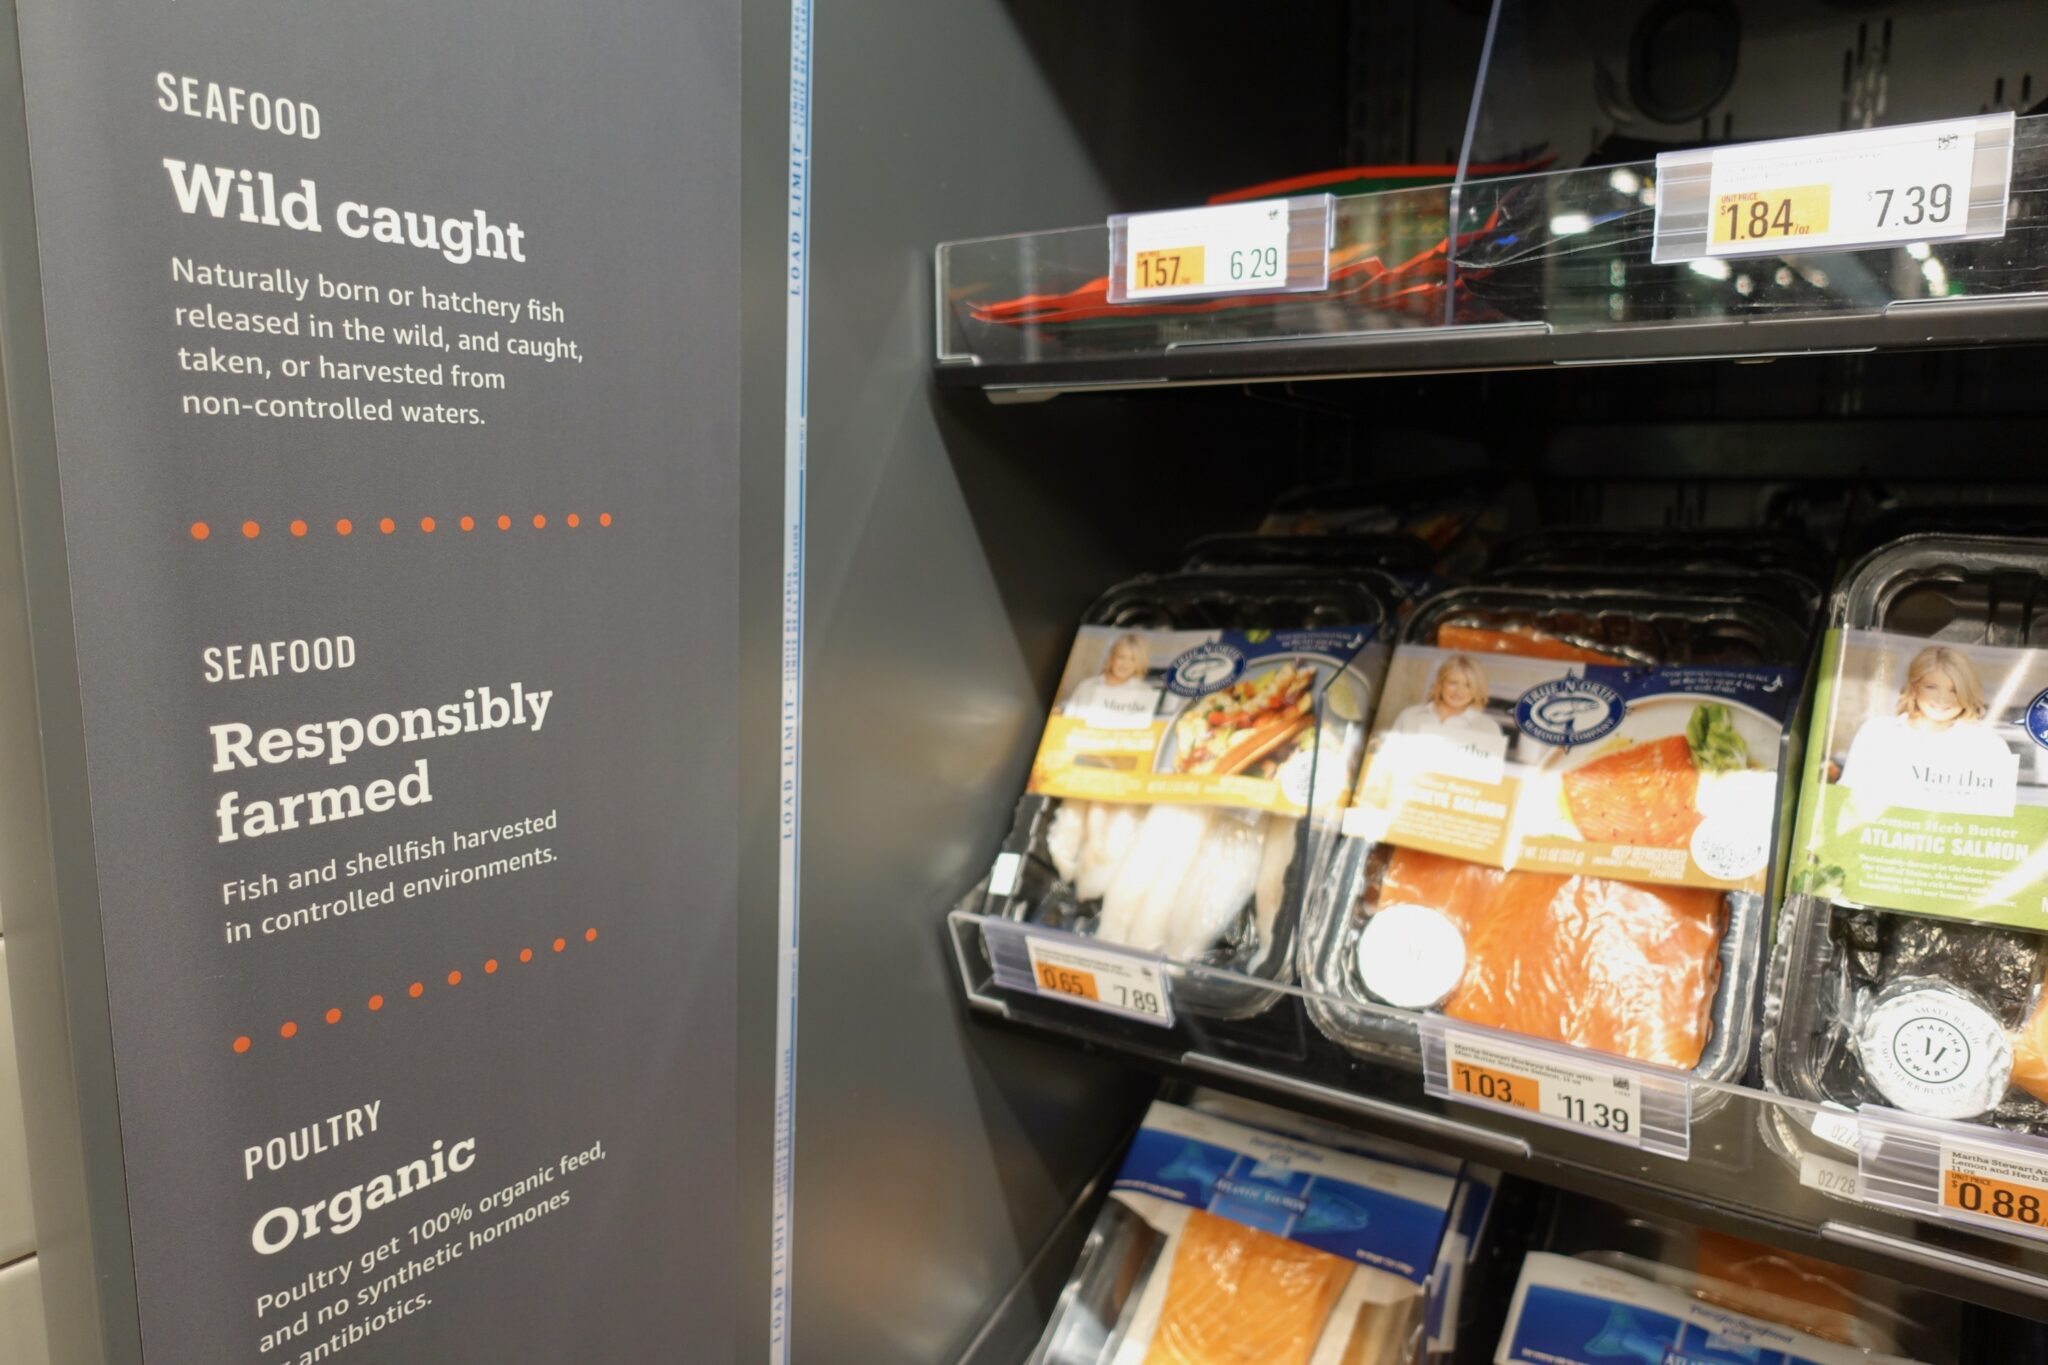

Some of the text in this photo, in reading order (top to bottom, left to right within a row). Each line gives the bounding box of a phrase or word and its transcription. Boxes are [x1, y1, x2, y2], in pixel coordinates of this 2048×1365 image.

[157, 72, 320, 139] SEAFOOD
[163, 158, 525, 264] Wild caught
[1739, 192, 1758, 201] PRICE
[172, 257, 564, 323] Naturally born or hatchery fish
[790, 231, 801, 296] LOAD
[176, 304, 582, 363] released in the wild, and caught,
[178, 347, 505, 389] taken, or harvested from
[183, 396, 485, 424] non-controlled waters.
[204, 636, 355, 682] SEAFOOD
[210, 682, 553, 772] Responsibly
[216, 759, 432, 843] farmed
[783, 779, 793, 838] LOAD
[1911, 764, 1994, 788] Martha
[223, 809, 556, 905] Fish and shellfish harvested
[1860, 827, 2030, 861] ATLANTIC SALMON
[1877, 816, 1921, 830] emon
[1968, 823, 2018, 839] Butter
[226, 848, 557, 943] in controlled environments.
[245, 1100, 380, 1180] POULTRY
[1952, 1152, 1989, 1164] Martha
[1992, 1159, 2033, 1173] Stewart
[1952, 1158, 1987, 1171] Lemon
[1990, 1167, 2010, 1175] and
[2012, 1170, 2039, 1182] Herb
[252, 1138, 475, 1254] Organic
[257, 1141, 606, 1317] Poultry get 100% organic feed,
[260, 1190, 570, 1352] and no synthetic hormones
[300, 1294, 432, 1365] antibiotics.
[772, 1287, 783, 1343] LOAD
